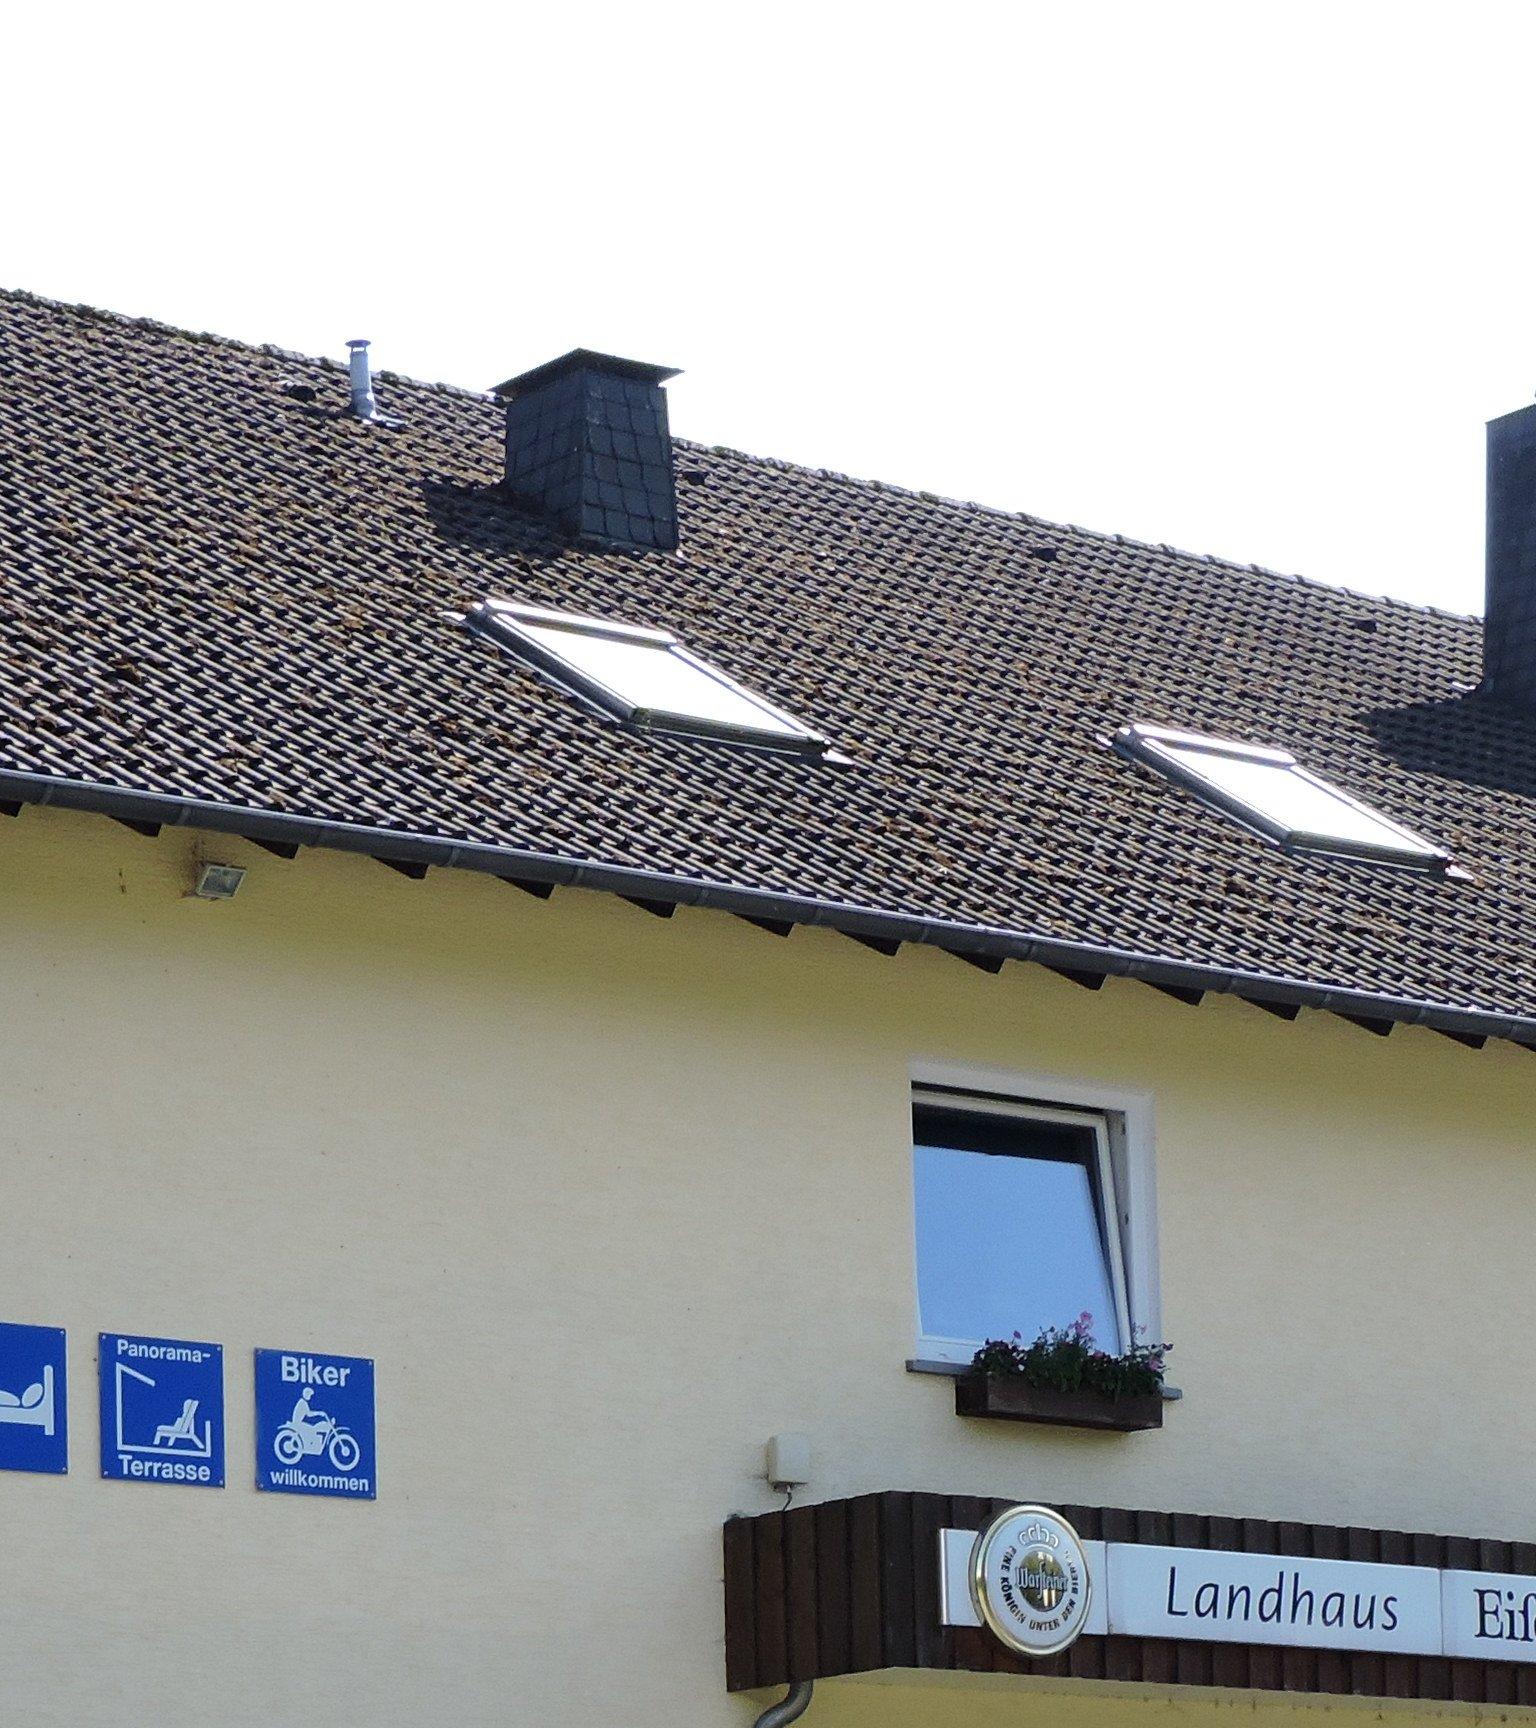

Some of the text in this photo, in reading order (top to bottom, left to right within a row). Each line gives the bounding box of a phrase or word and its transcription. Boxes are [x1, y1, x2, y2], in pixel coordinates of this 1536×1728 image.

[117, 1339, 211, 1363] Panorama-
[281, 1355, 351, 1388] Biker
[117, 1454, 212, 1482] Terrasse
[269, 1468, 370, 1492] willkommen
[1167, 1566, 1399, 1631] Landhaus
[1029, 1618, 1060, 1632] UNTER
[1062, 1598, 1076, 1622] DEN
